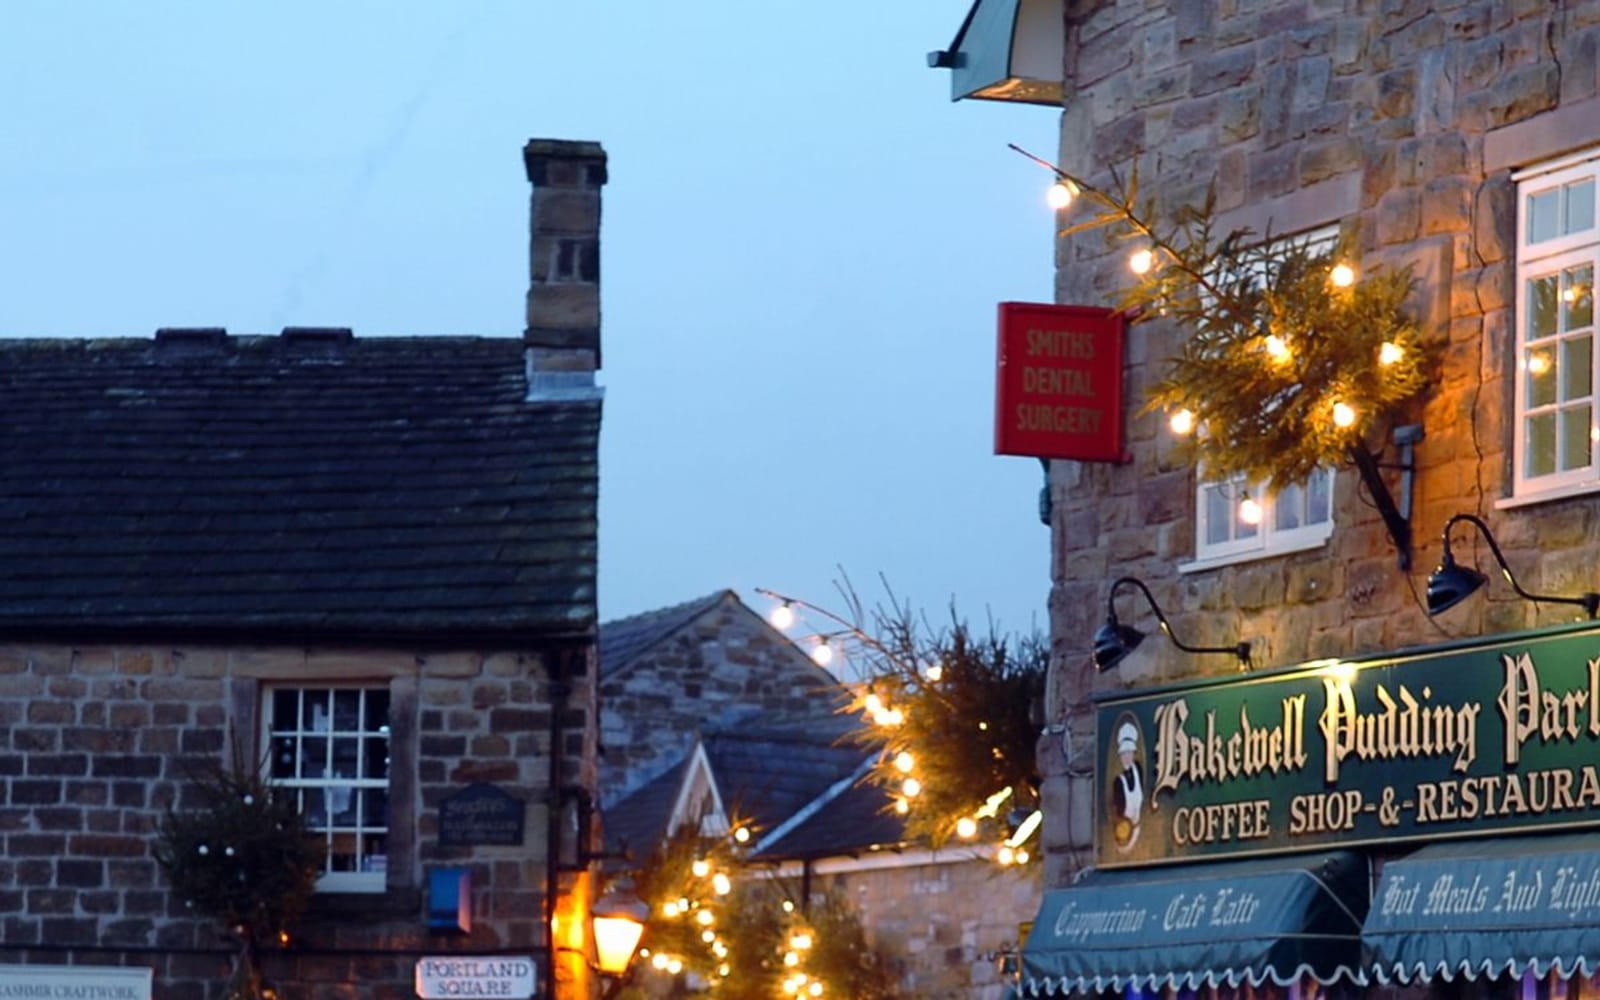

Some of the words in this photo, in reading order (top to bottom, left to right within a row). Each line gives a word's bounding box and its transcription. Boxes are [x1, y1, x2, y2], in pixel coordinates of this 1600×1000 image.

[1026, 329, 1095, 360] SMITHS
[1023, 367, 1095, 396] DENTAL
[1016, 404, 1103, 434] SURGERY
[1151, 694, 1308, 809] Bakewell
[1318, 676, 1481, 784] Pudding
[1172, 801, 1271, 845] COFFEE
[1381, 875, 1421, 917] Hot
[1422, 874, 1490, 916] Meals
[1492, 869, 1543, 913] And
[425, 961, 529, 978] PORTLAND
[0, 983, 52, 997] ASHMIR
[437, 980, 512, 995] SQUARE
